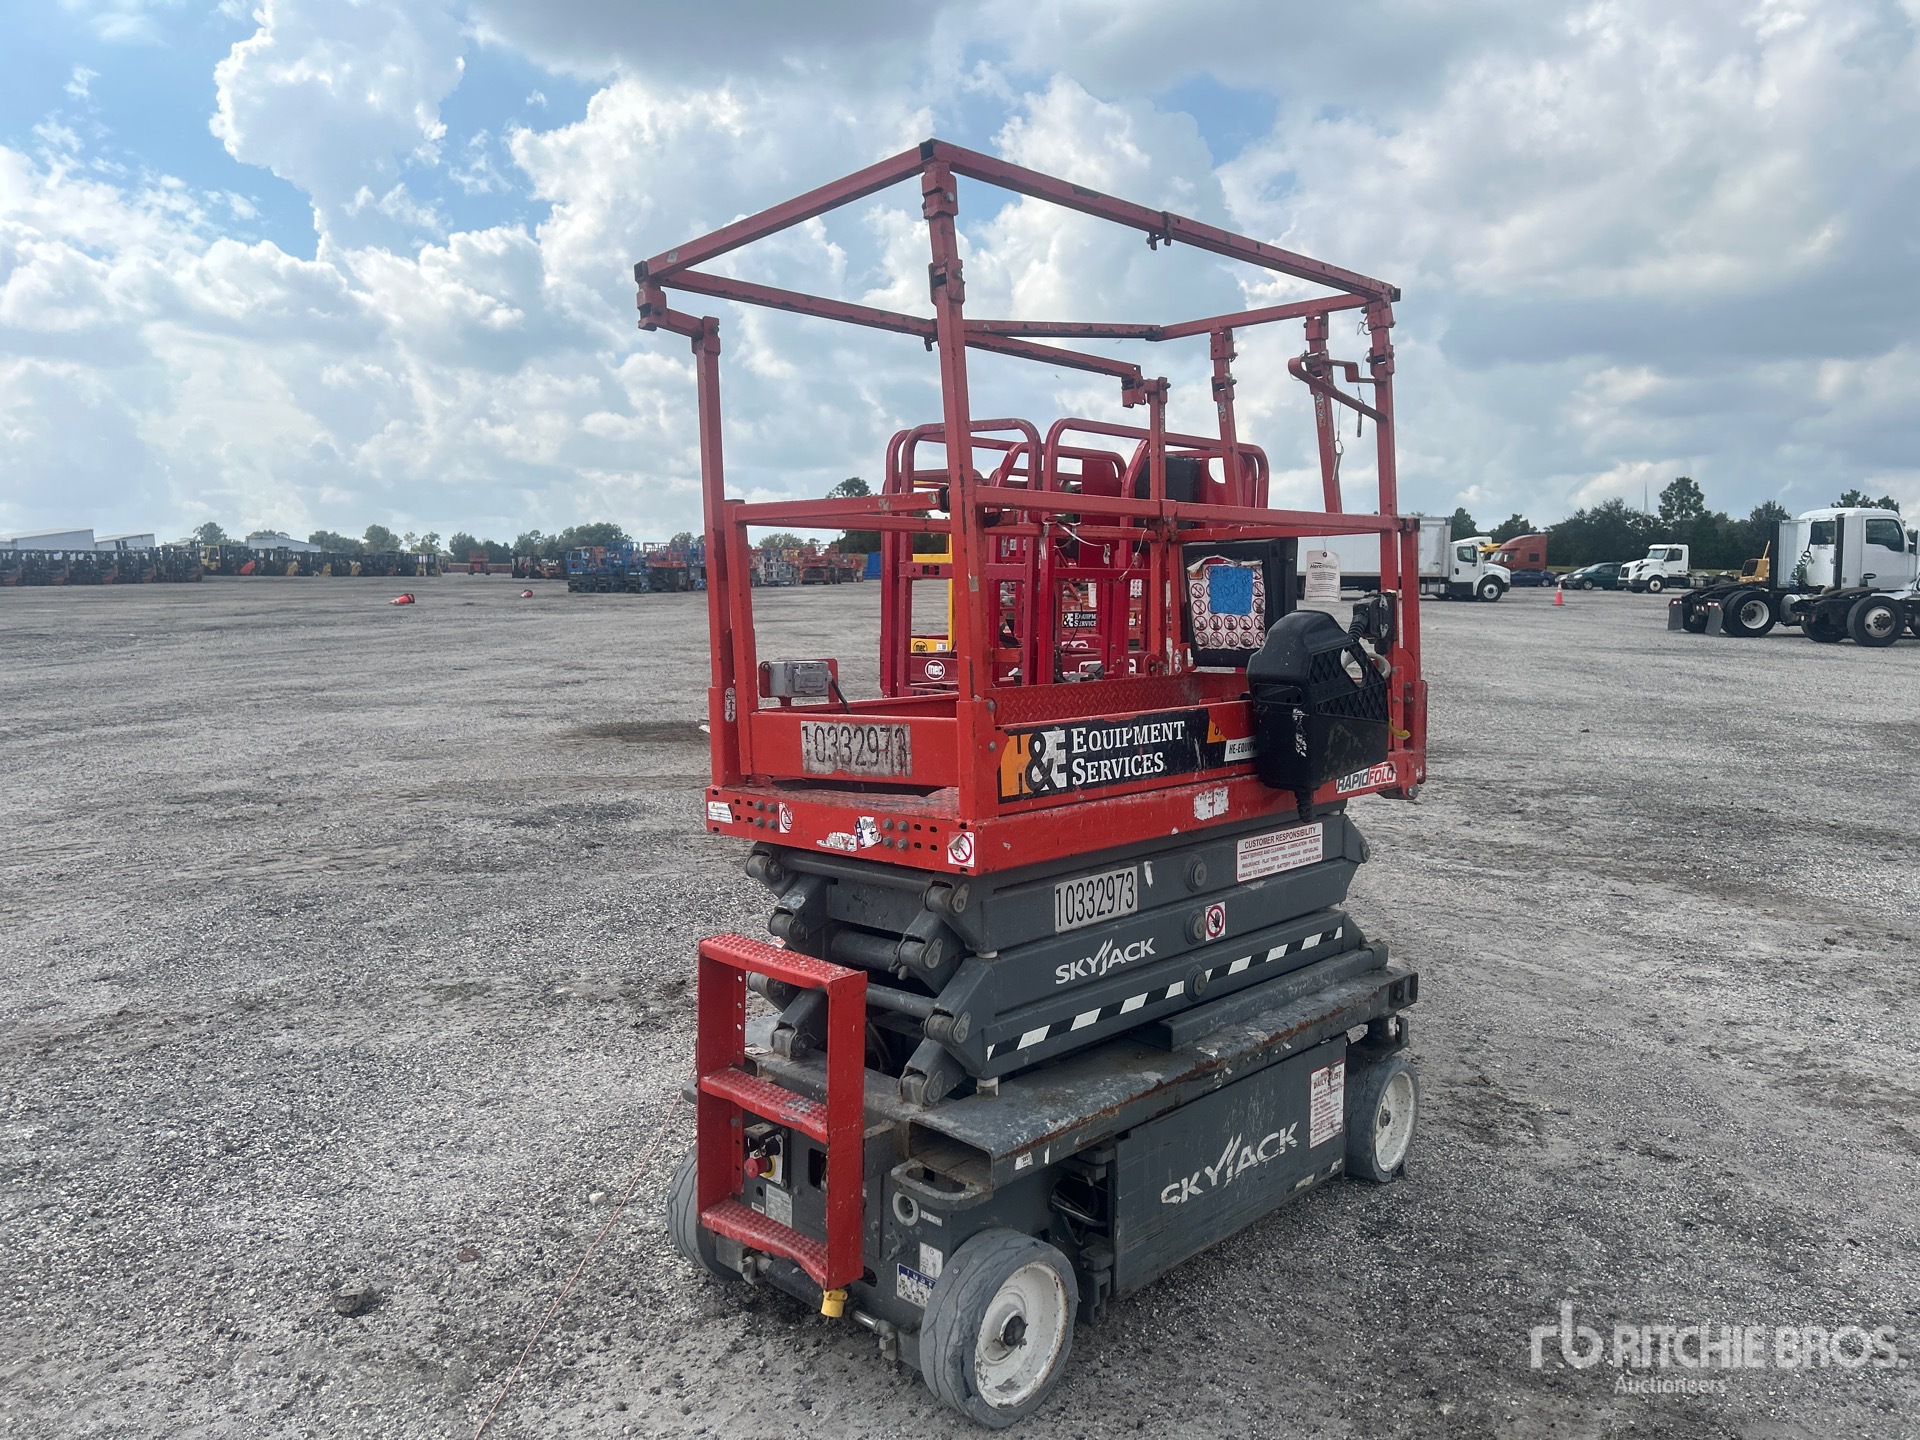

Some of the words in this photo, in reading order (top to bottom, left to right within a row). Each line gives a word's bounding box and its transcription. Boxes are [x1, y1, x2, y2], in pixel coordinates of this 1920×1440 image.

[1001, 729, 1067, 797] H&E
[1071, 720, 1185, 754] EQUIPMENT
[1072, 751, 1165, 786] SERVICES
[1244, 836, 1275, 849] CUSTOMER
[1275, 826, 1317, 843] RESPONSIBILITY
[1056, 871, 1135, 927] 10332973
[1055, 938, 1157, 985] SKYJACK
